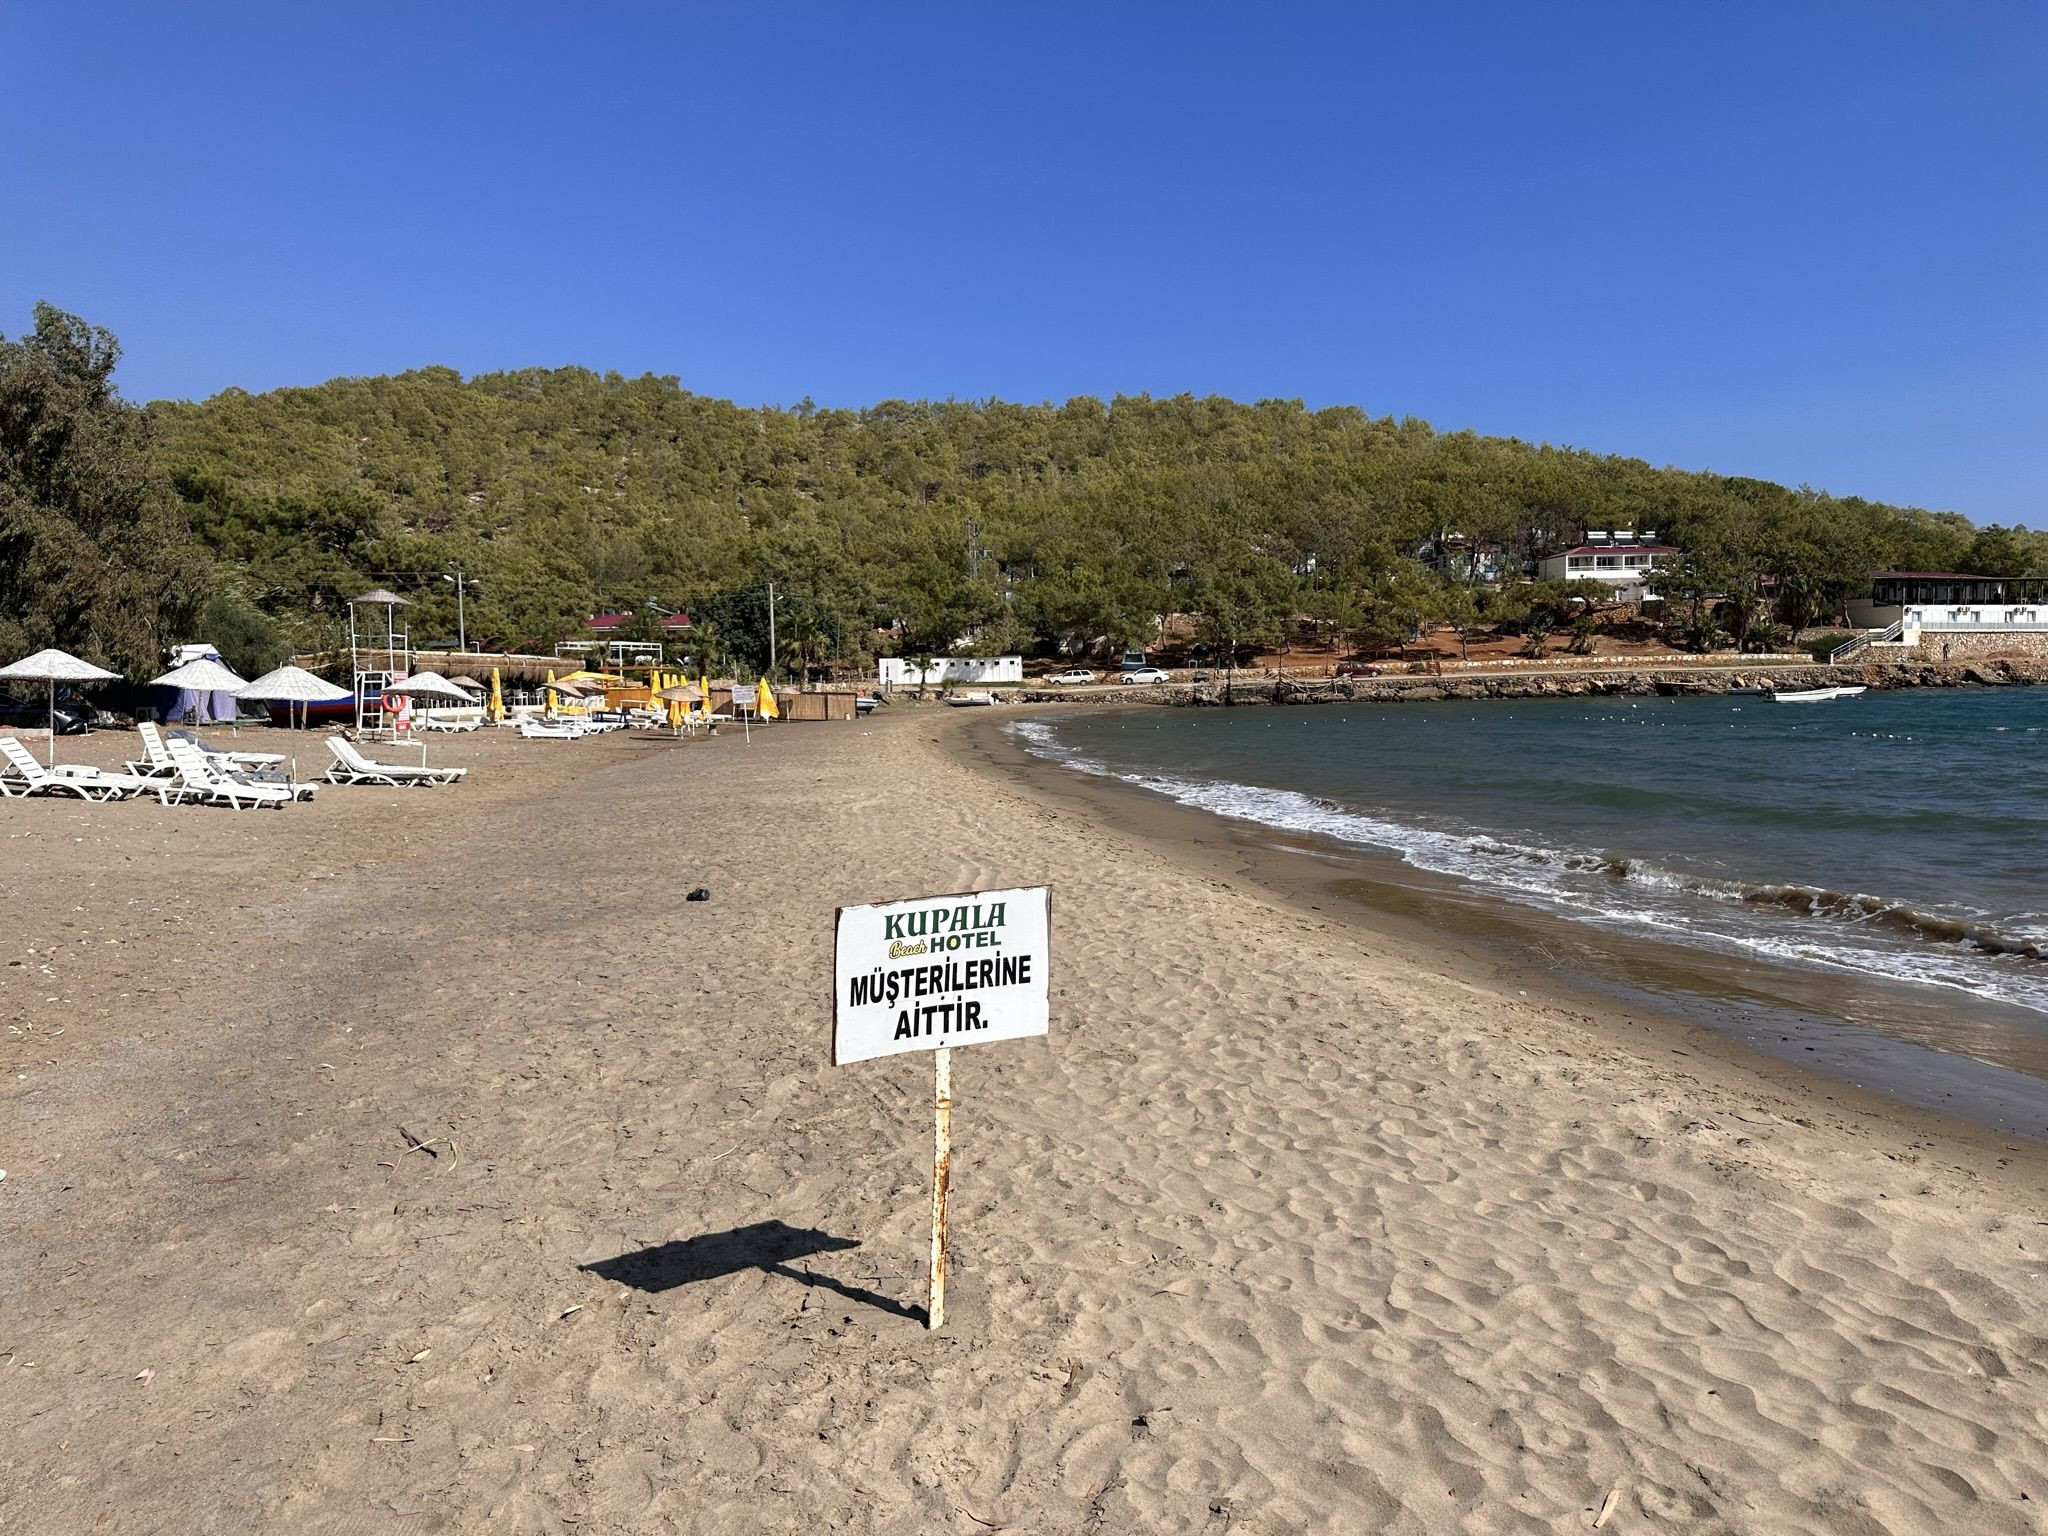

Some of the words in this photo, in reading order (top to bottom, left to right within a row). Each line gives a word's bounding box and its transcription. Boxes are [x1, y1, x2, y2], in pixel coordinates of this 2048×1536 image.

[884, 902, 1006, 940] KUPALA
[889, 939, 927, 959] Beach
[930, 931, 1001, 953] HOTEL
[850, 951, 1031, 1008] MÜŞTERİLERİNE
[894, 996, 988, 1040] AİTTİR.
